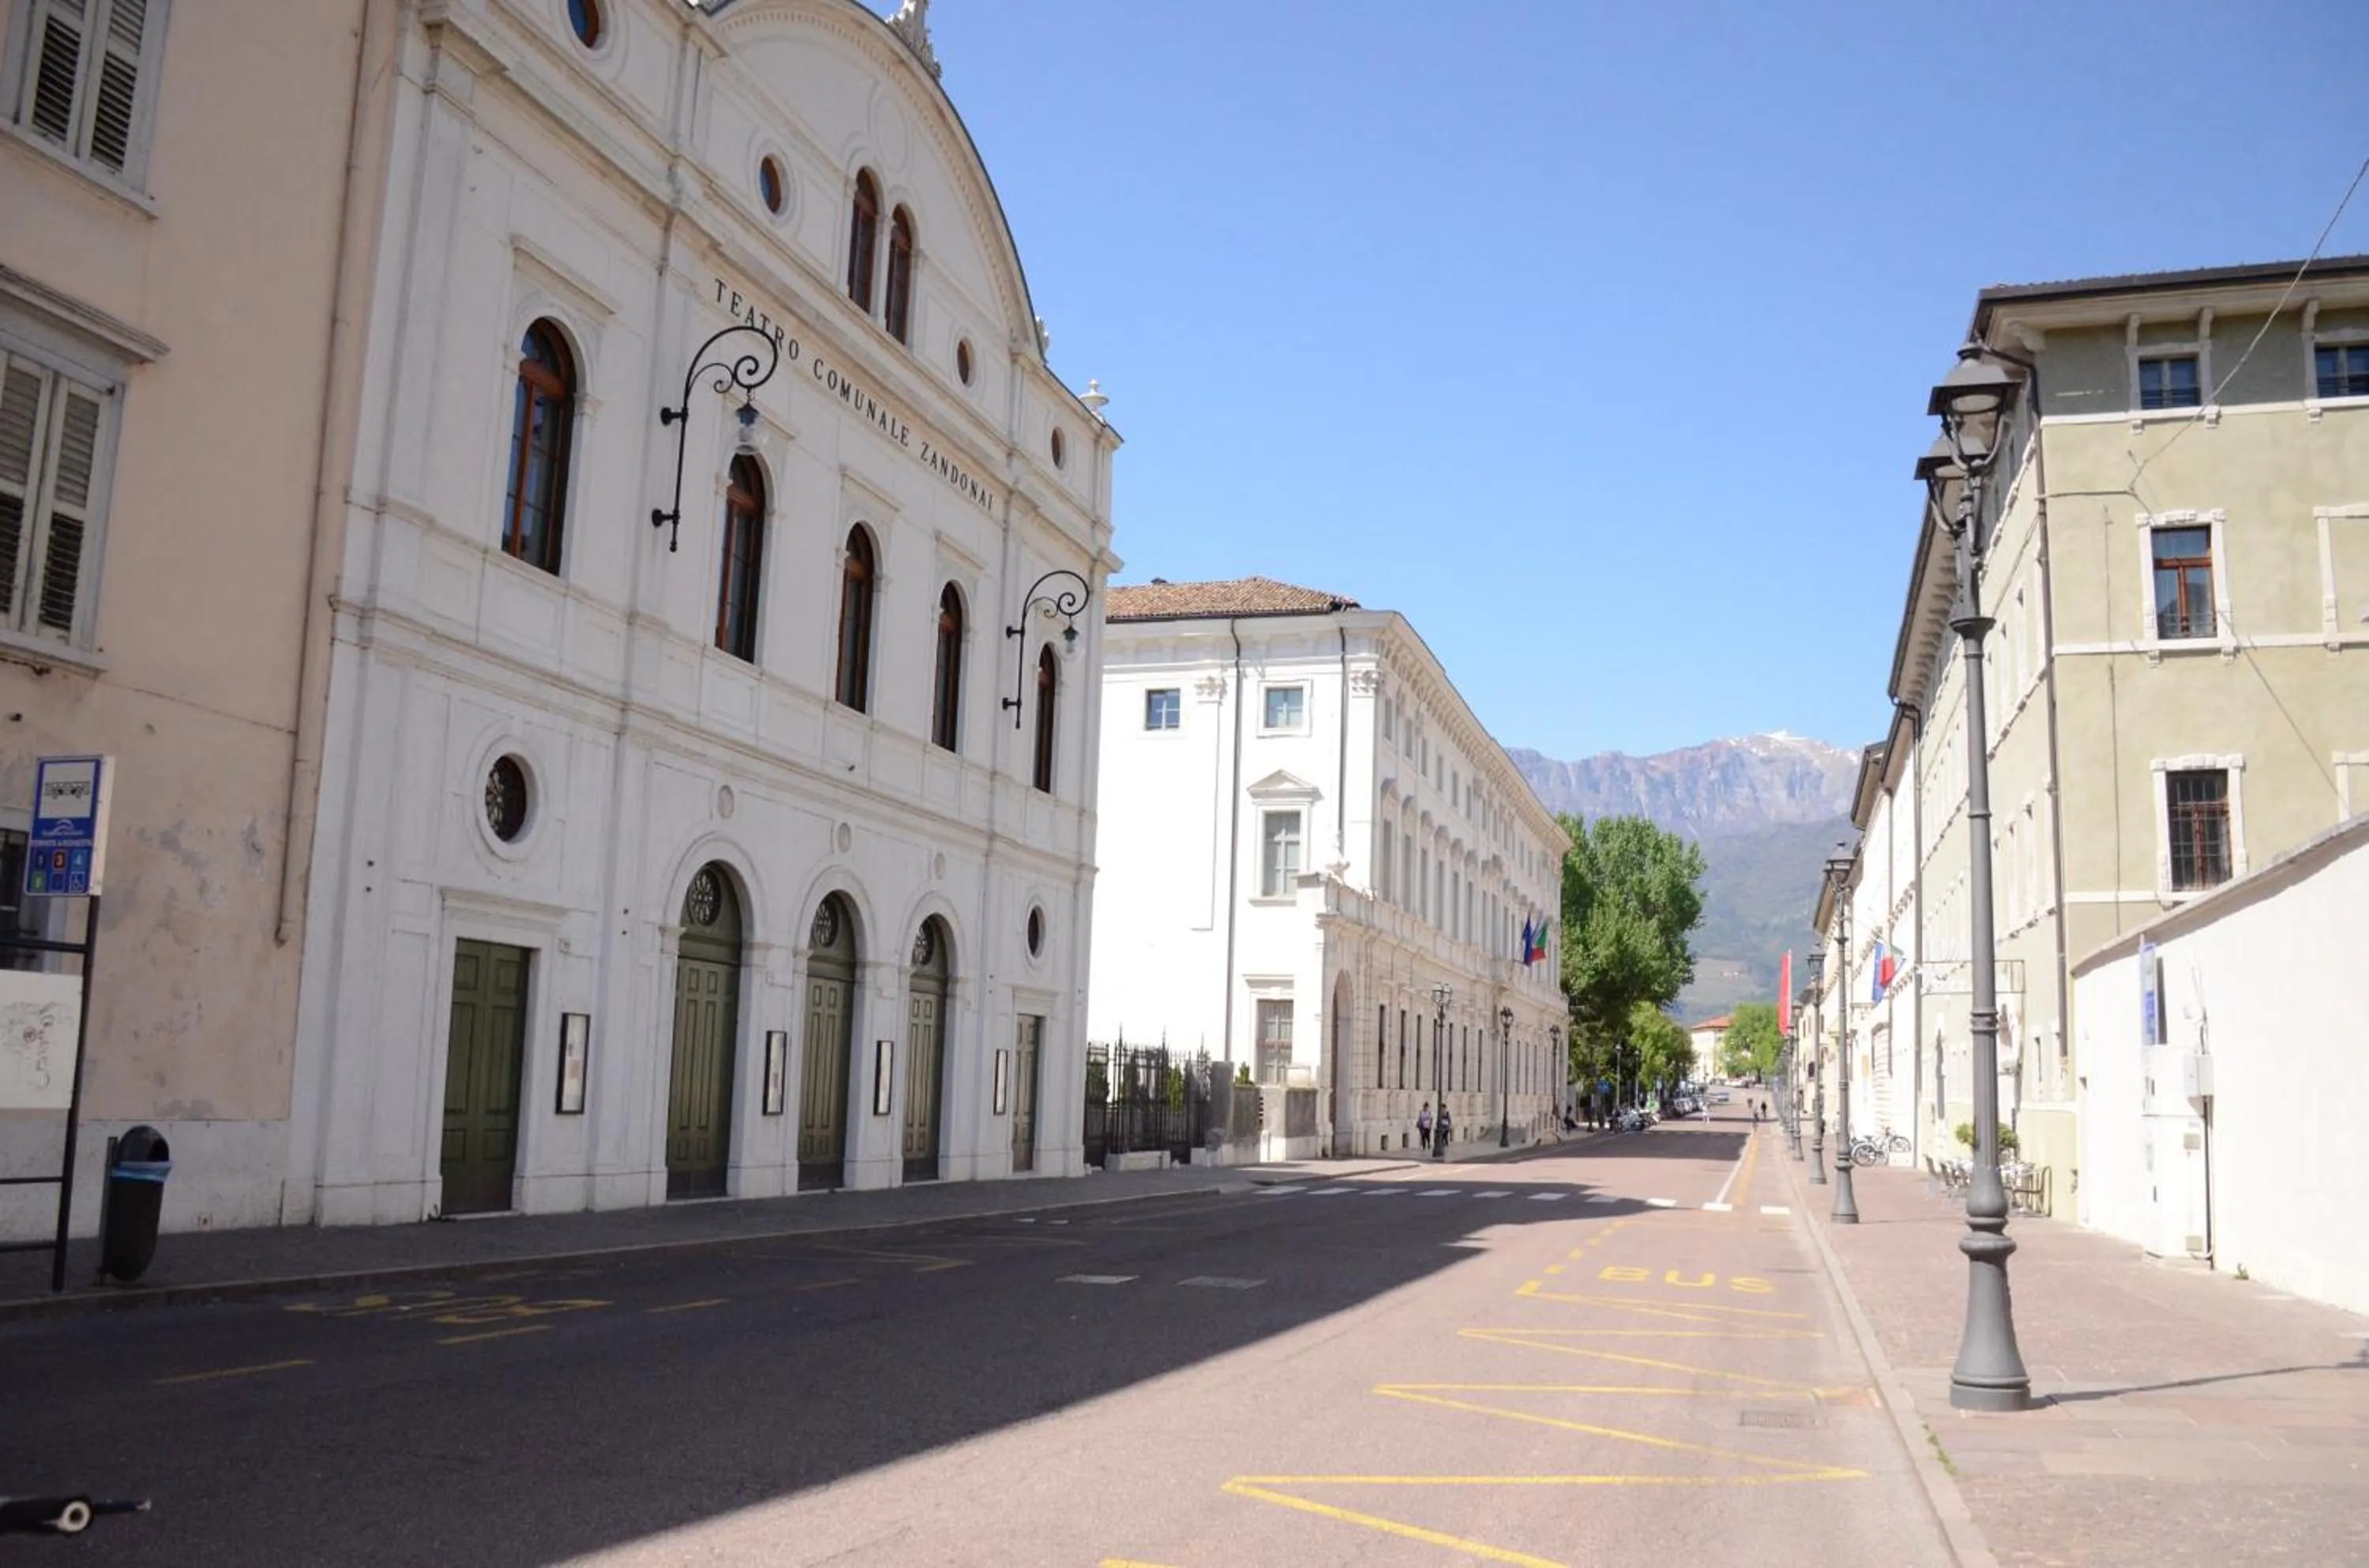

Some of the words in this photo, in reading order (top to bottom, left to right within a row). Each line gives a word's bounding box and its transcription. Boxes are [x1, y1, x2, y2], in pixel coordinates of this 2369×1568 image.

[715, 277, 799, 360] TEATRO
[813, 358, 910, 447] COMUNALE
[920, 441, 993, 512] ZANDONAI
[1597, 1265, 1775, 1293] BUS
